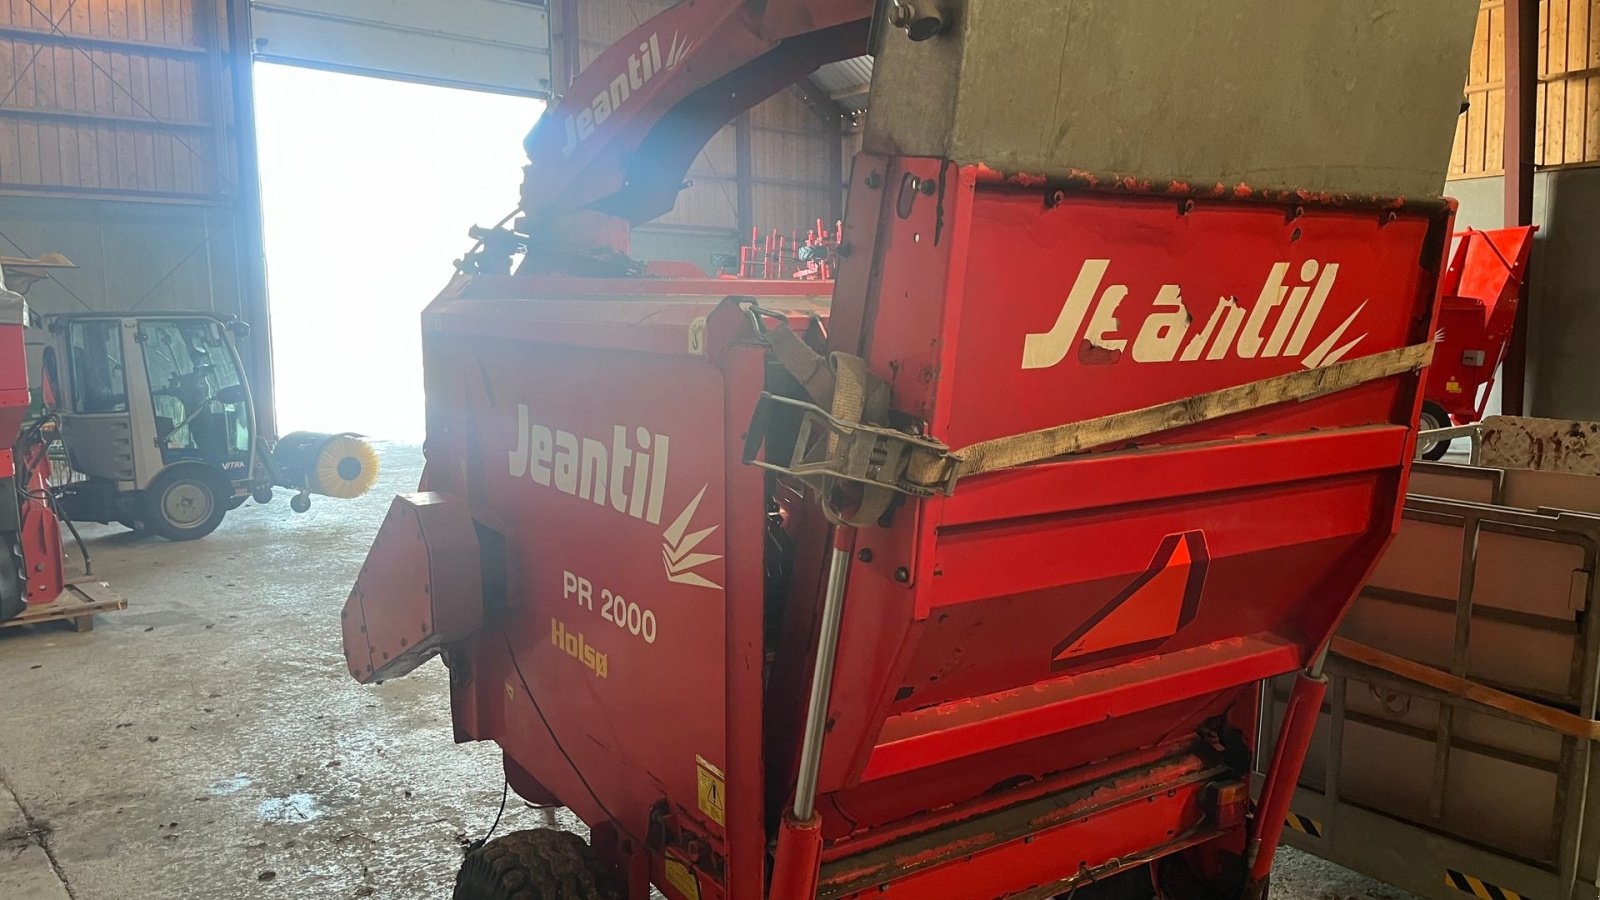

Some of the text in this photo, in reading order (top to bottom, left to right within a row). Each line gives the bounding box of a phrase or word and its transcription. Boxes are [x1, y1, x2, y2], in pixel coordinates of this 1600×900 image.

[562, 33, 662, 157] Jeantil
[1022, 259, 1340, 369] Jeantil
[221, 461, 245, 470] VITRA
[508, 403, 669, 525] Jeantil
[551, 617, 608, 679] Holsø
[563, 570, 657, 644] PR 2000
